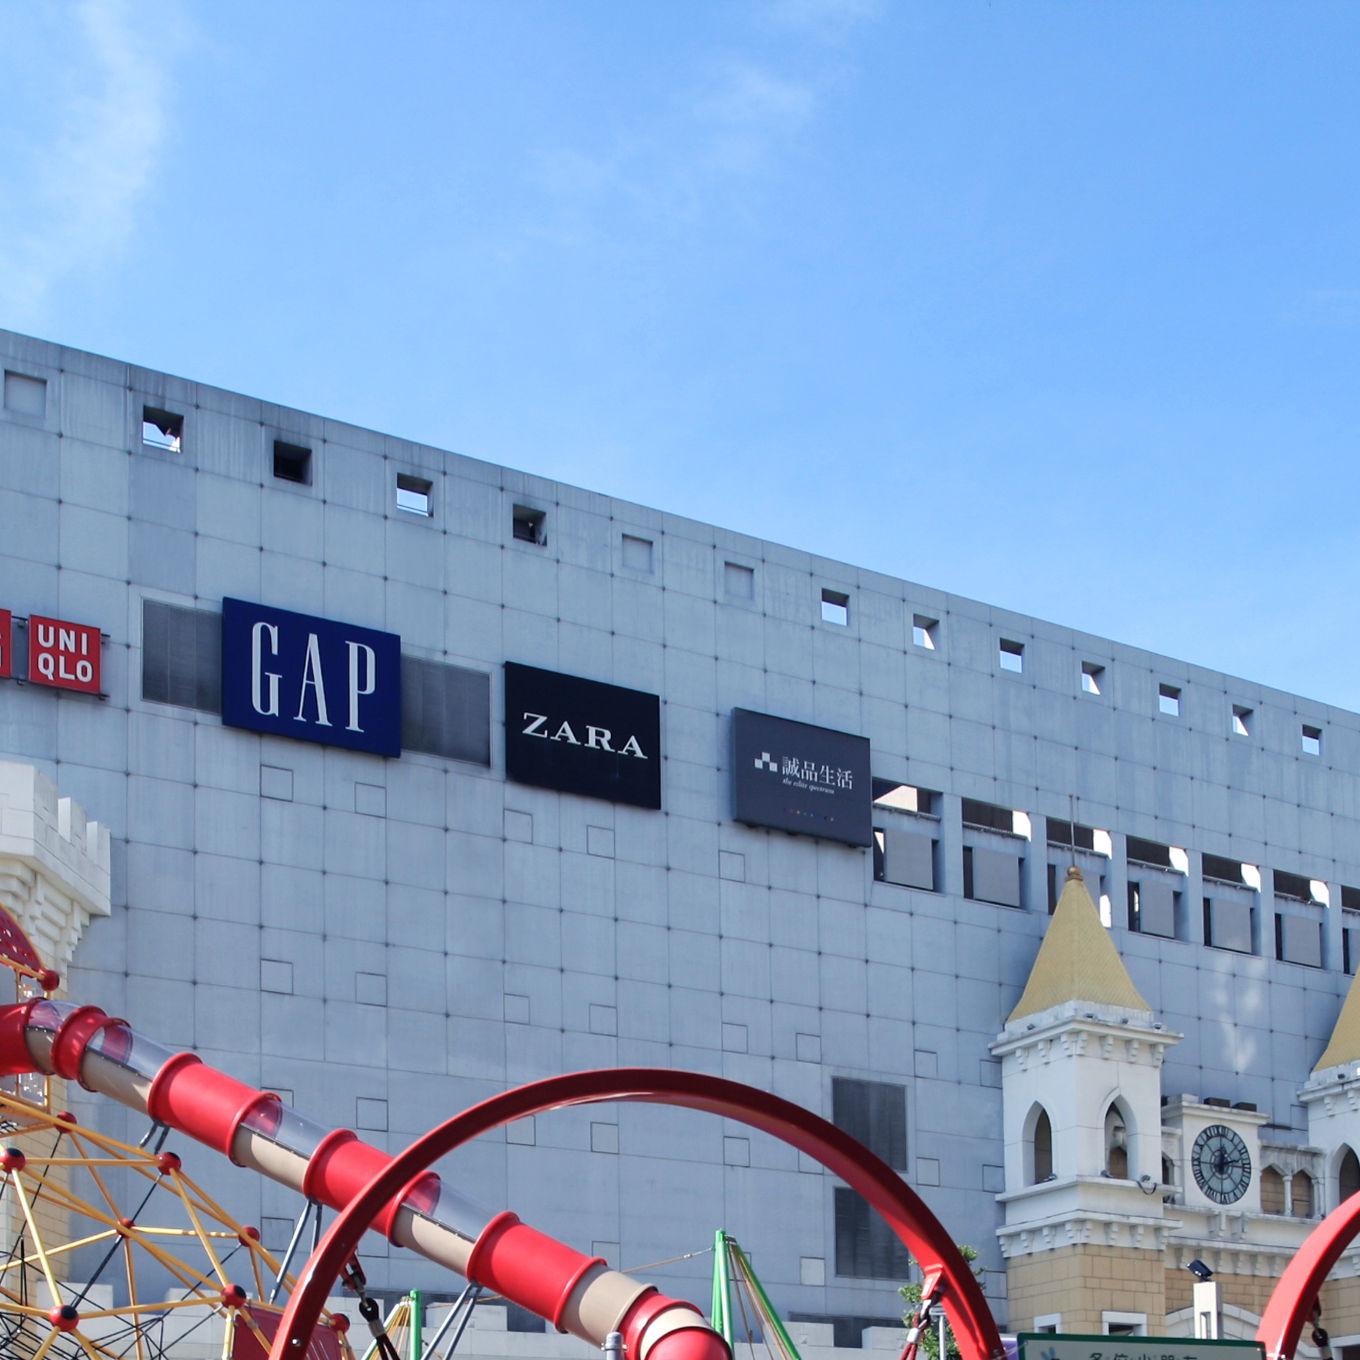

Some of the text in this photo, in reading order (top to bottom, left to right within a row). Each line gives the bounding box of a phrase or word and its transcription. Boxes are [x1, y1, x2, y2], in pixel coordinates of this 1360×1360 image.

[37, 624, 88, 656] UNI
[37, 652, 93, 683] QLO
[251, 621, 376, 733] GAP
[522, 711, 648, 759] ZARA
[782, 756, 853, 790] 誠品生活
